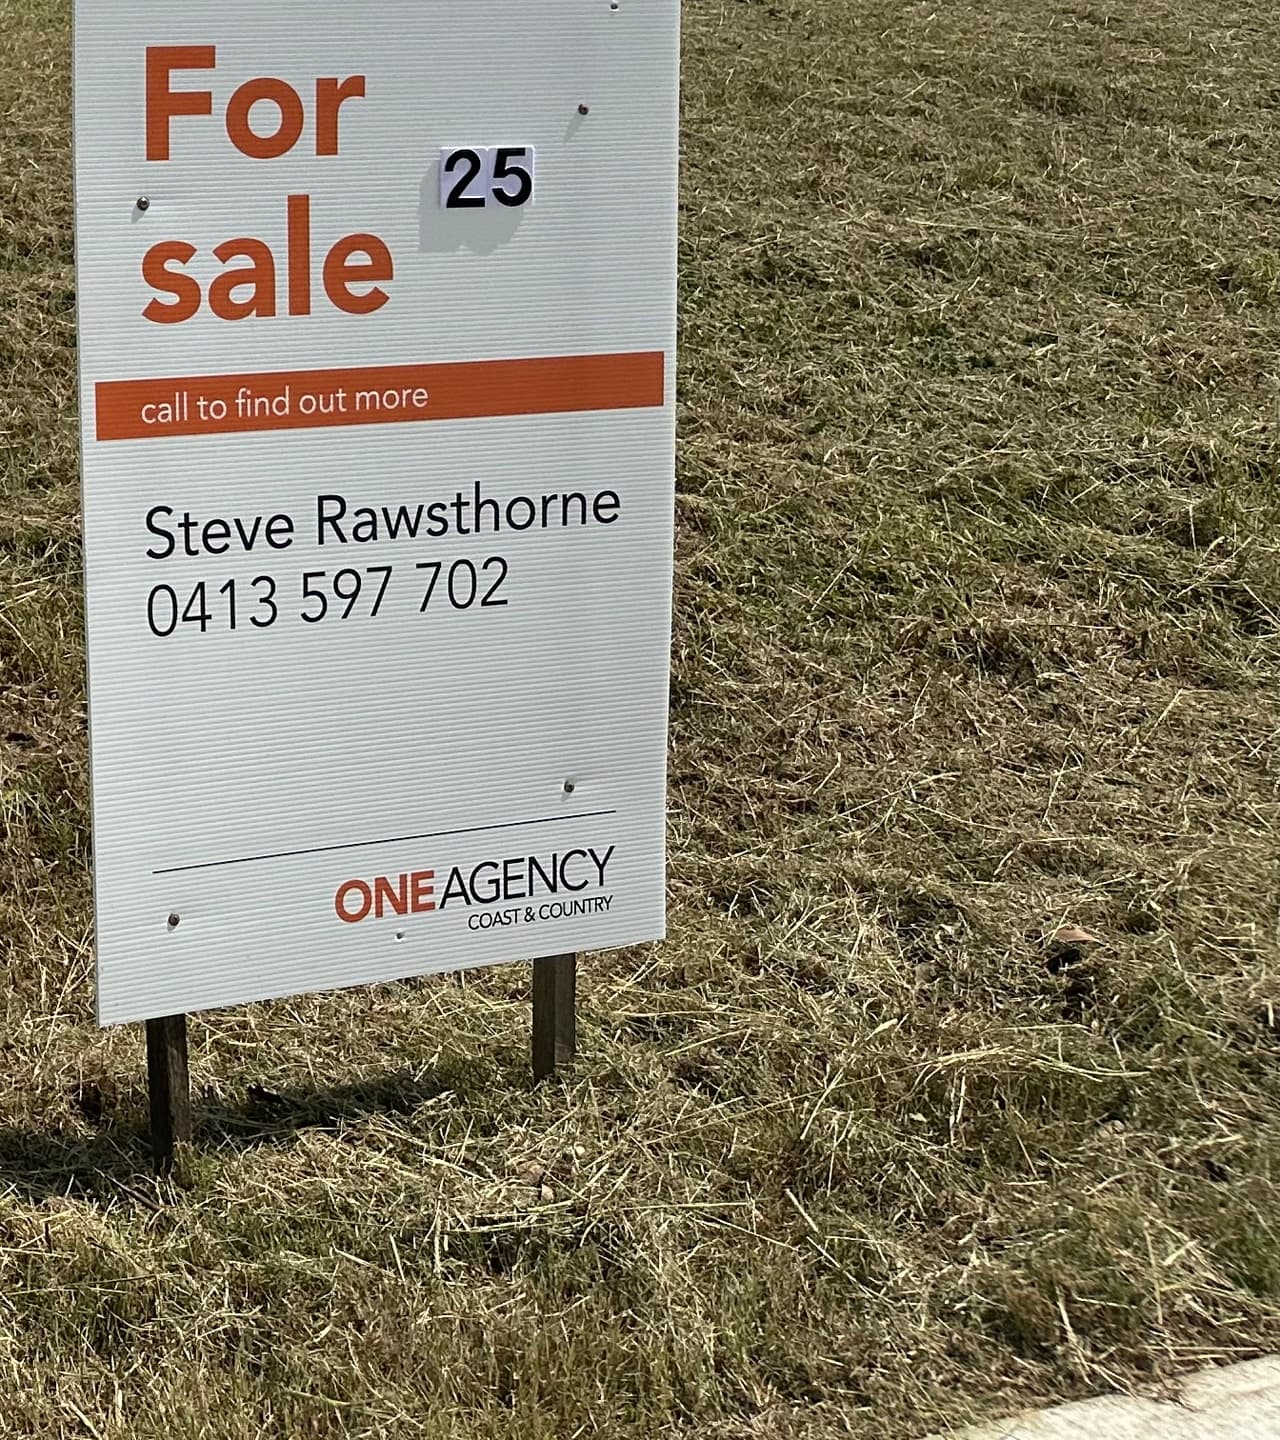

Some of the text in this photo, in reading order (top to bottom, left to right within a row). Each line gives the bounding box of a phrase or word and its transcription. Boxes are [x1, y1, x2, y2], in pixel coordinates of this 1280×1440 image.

[145, 44, 366, 161] For
[444, 147, 533, 208] 25
[141, 194, 394, 324] sale
[140, 384, 429, 425] call to find out more
[145, 480, 622, 560] Steve Rawsthorne
[146, 556, 510, 638] 0413 597 702
[467, 895, 614, 931] COAST & COUNTRY
